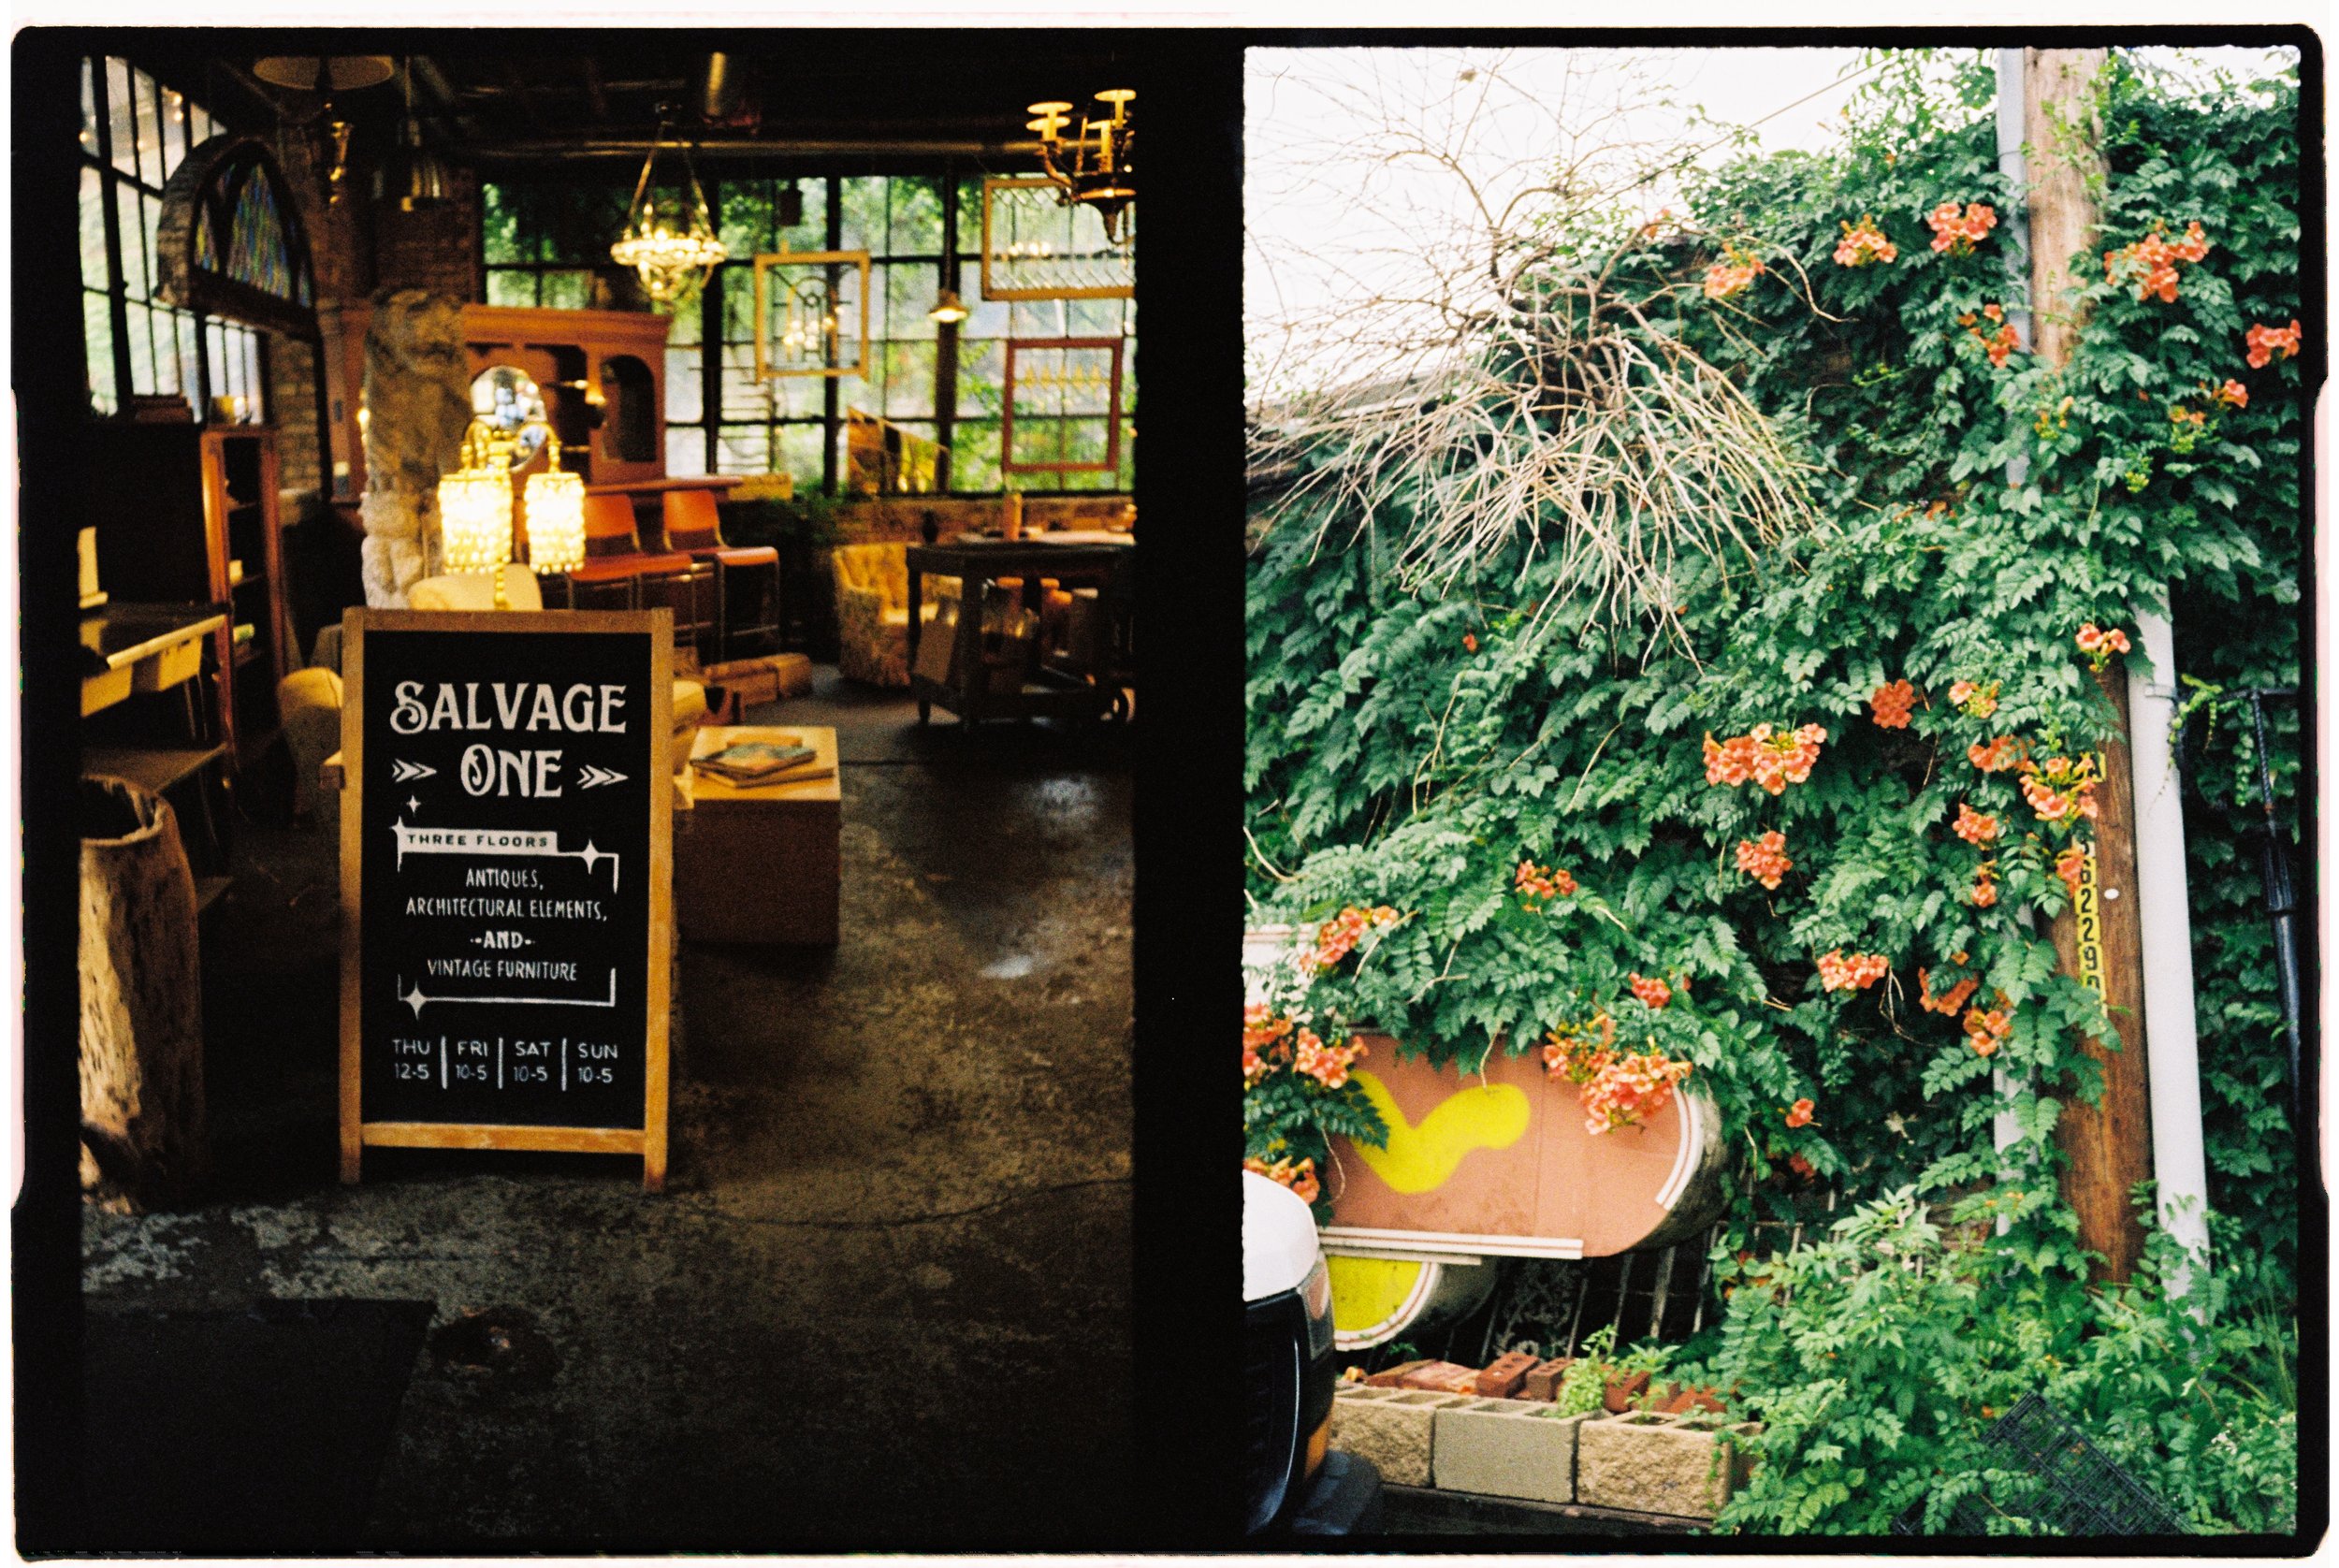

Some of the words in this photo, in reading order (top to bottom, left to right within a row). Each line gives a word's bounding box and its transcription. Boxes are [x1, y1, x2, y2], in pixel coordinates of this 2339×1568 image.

[390, 680, 627, 734] SALVAGE
[460, 744, 562, 797] ONE
[407, 834, 467, 846] THREE
[477, 835, 548, 848] FLOORS
[466, 868, 544, 891] ANTIQUES,
[406, 897, 525, 918] ARCHITECTURAL
[530, 899, 607, 922] ELEMENTS,
[428, 959, 491, 979] VINTAGE
[498, 960, 577, 981] FURNITURE
[393, 1039, 430, 1055] THU
[458, 1040, 488, 1057] FRI
[515, 1041, 552, 1058] SAT
[577, 1042, 618, 1059] SUN
[395, 1063, 429, 1080] 12-5
[456, 1064, 487, 1082] 10-5
[514, 1066, 548, 1082] 10-5
[577, 1067, 613, 1083] 10-5
